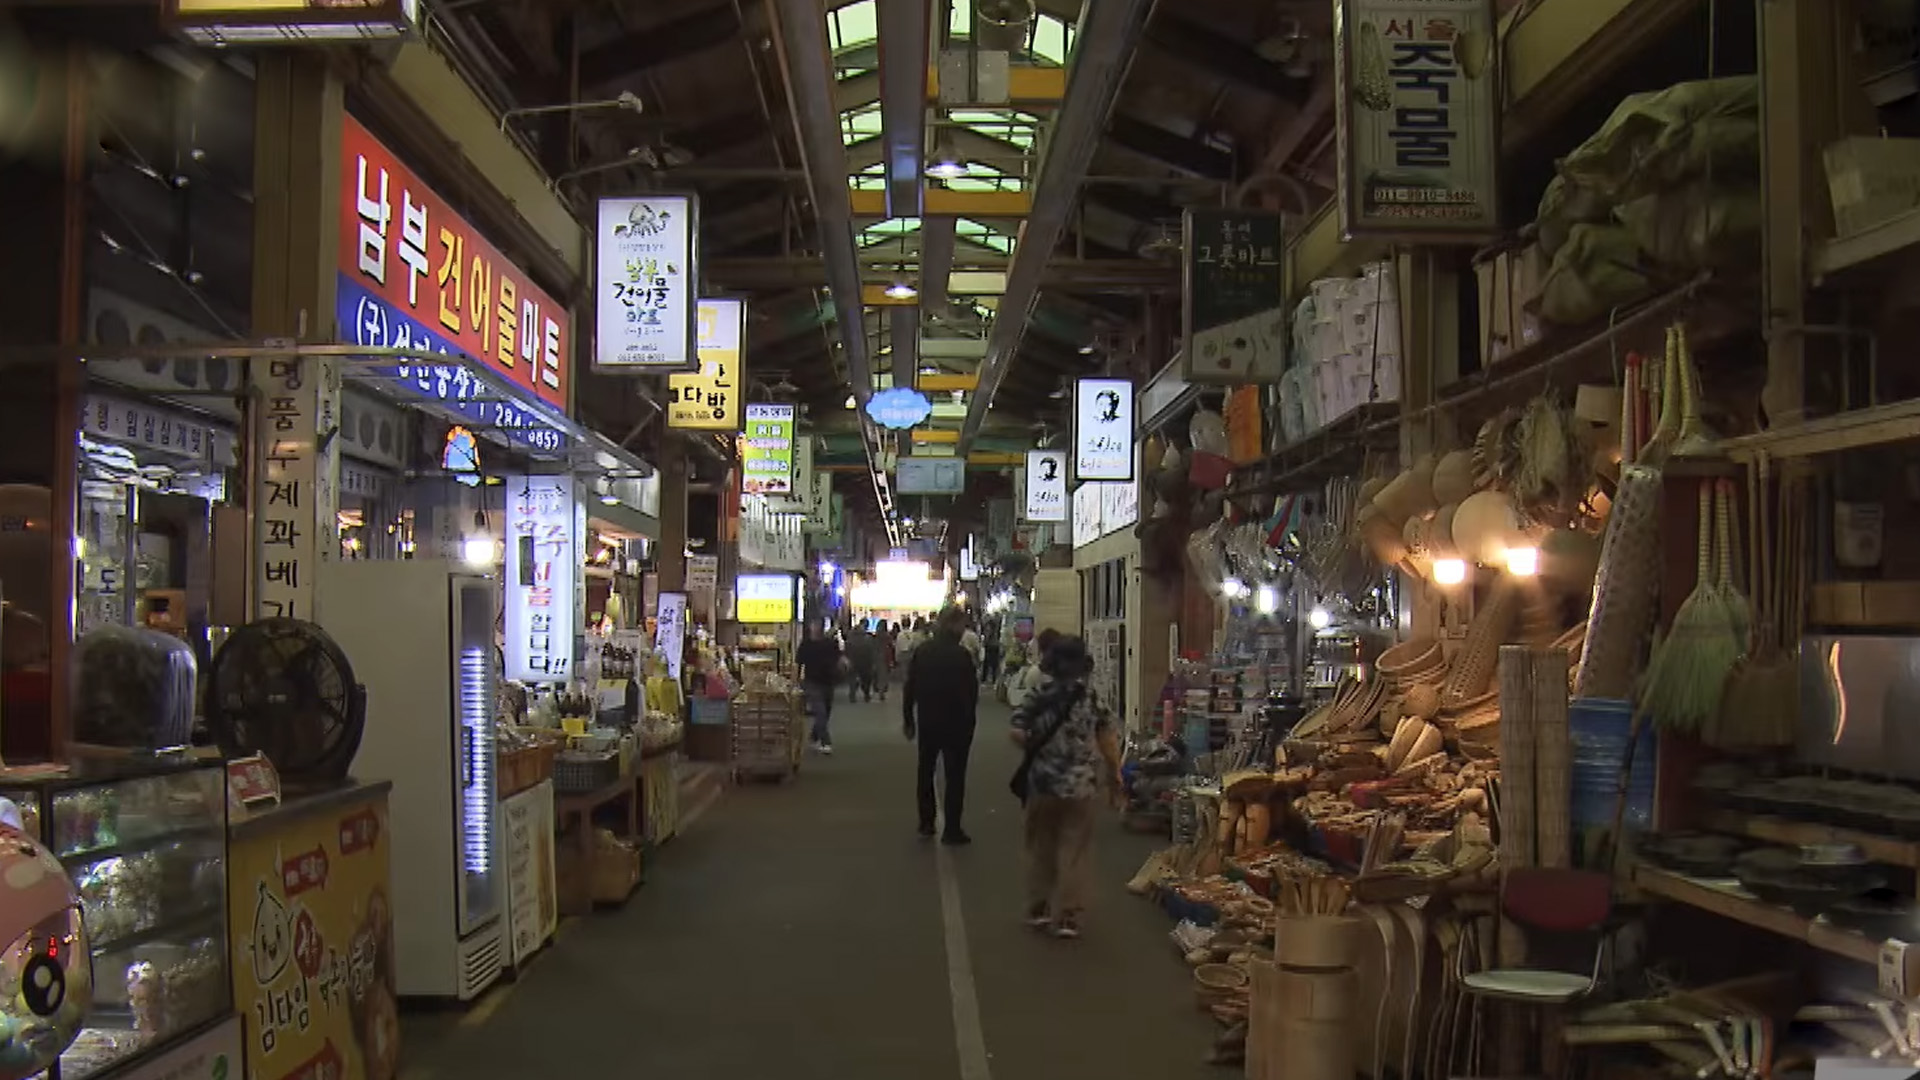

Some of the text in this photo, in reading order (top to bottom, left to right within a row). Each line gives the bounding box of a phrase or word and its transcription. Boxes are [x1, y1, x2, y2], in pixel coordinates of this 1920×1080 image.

[1384, 18, 1456, 41] 서울
[1388, 43, 1457, 167] 죽물
[626, 257, 660, 285] 남부
[612, 277, 670, 309] 건어물
[626, 306, 661, 325] 마트
